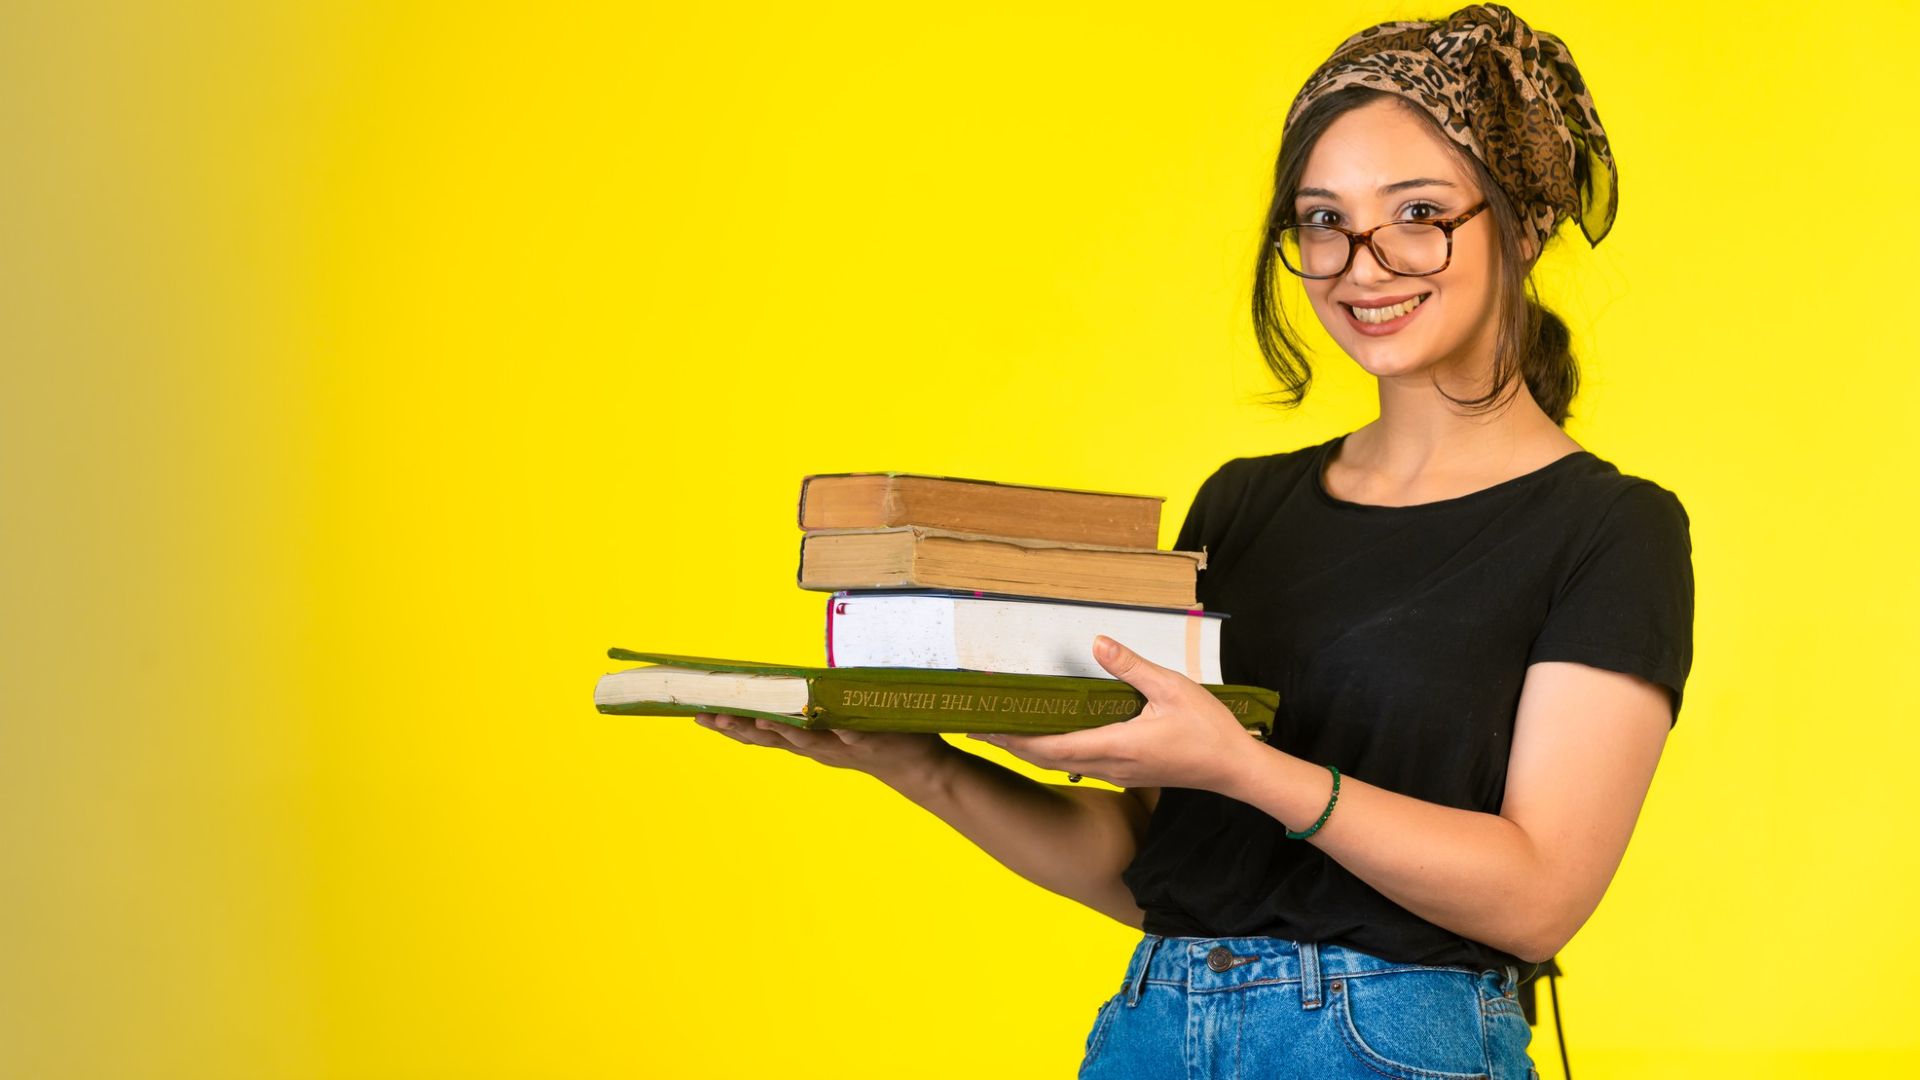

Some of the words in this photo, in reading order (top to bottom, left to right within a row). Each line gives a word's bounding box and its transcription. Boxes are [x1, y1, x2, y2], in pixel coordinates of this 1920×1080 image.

[842, 690, 936, 709] HERMITAGE
[940, 694, 973, 711] THE
[977, 695, 998, 712] IN
[1001, 696, 1079, 715] PAINTING
[1087, 700, 1140, 716] OPEAN
